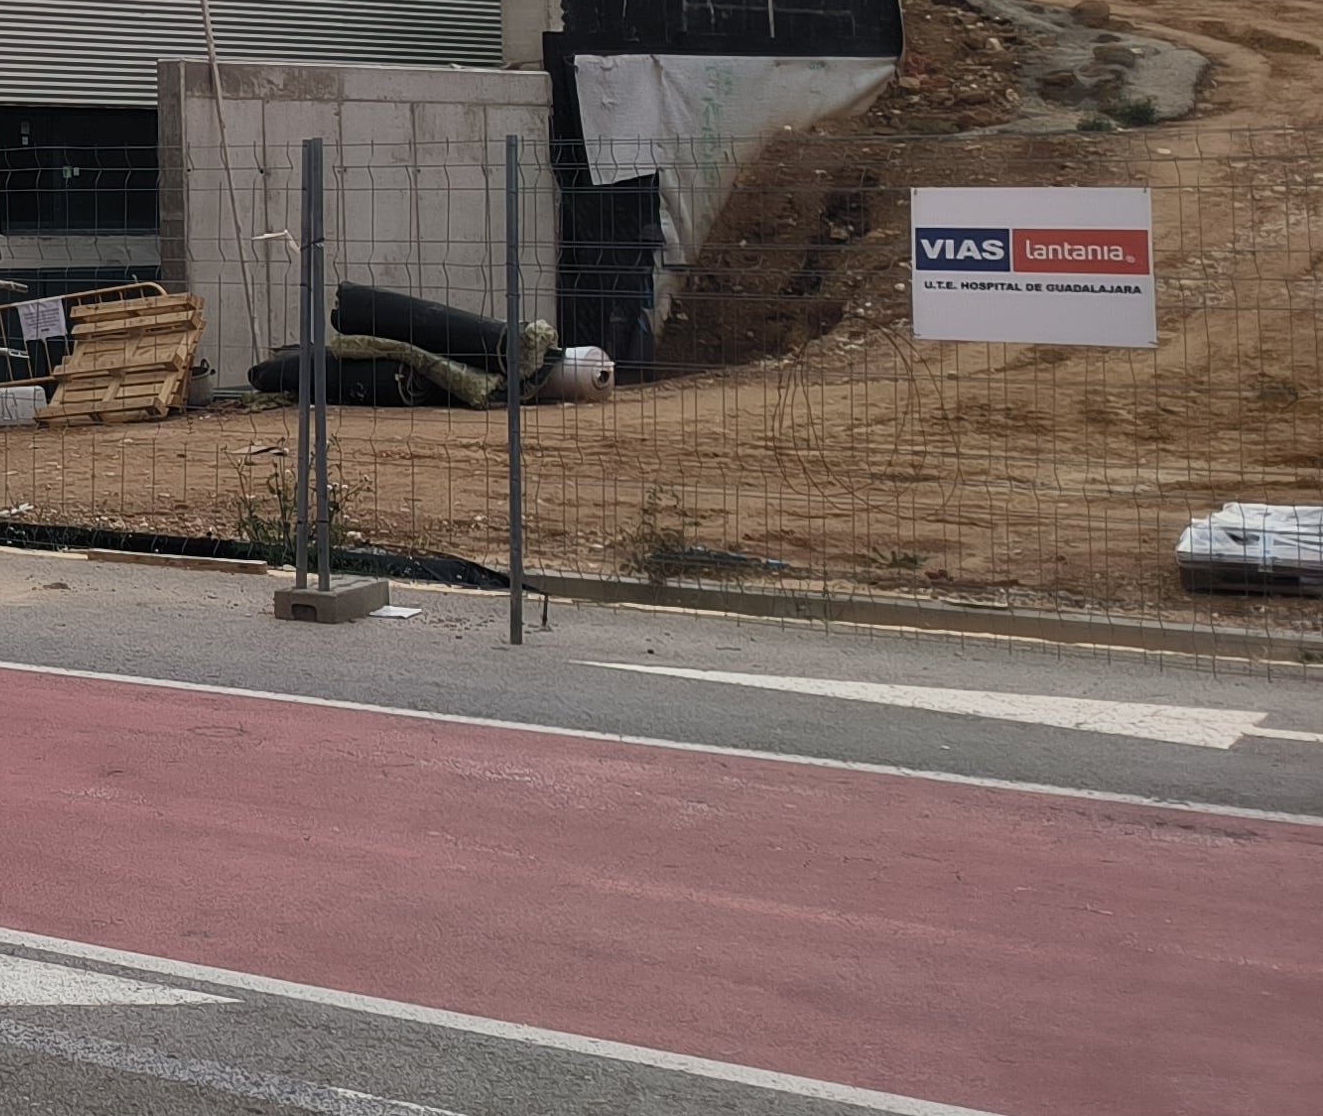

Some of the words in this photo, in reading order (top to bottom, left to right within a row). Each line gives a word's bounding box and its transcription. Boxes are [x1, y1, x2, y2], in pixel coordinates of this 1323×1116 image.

[920, 239, 1005, 260] VIAS
[924, 281, 958, 290] U.T.E.
[960, 282, 1023, 292] HOSPITAL
[1025, 284, 1042, 292] DE
[1046, 284, 1142, 295] GUADALAJARA
